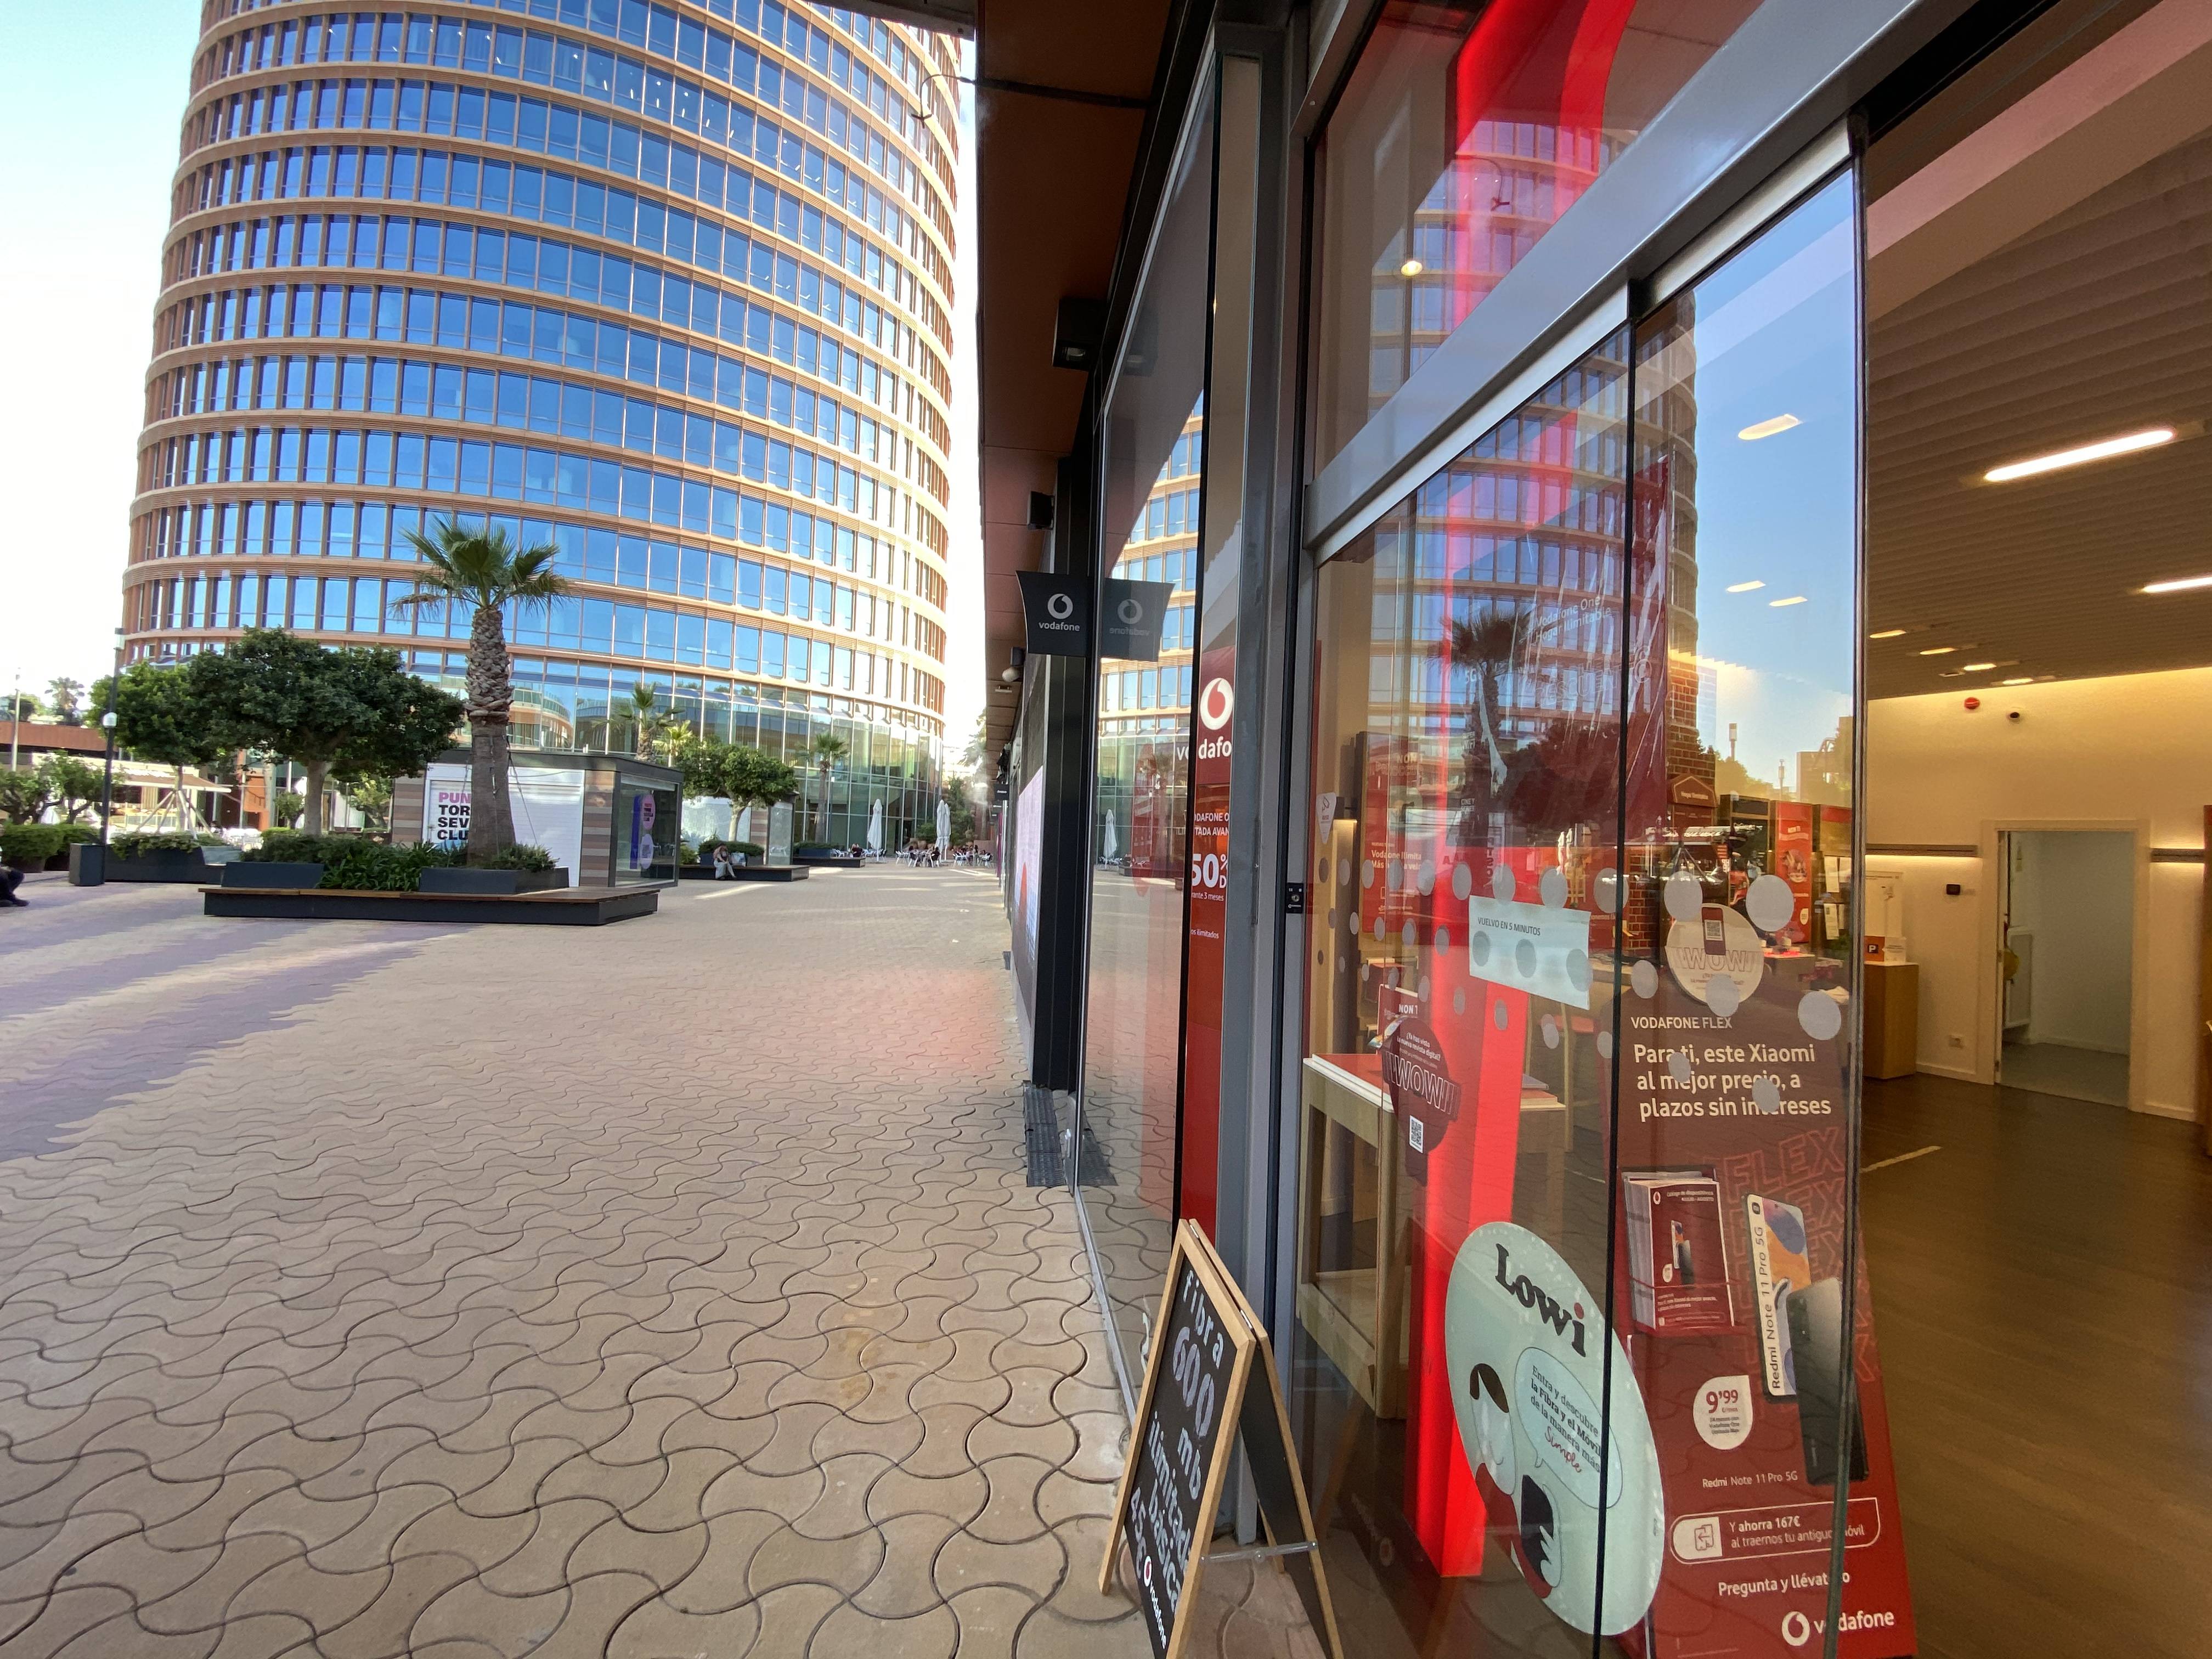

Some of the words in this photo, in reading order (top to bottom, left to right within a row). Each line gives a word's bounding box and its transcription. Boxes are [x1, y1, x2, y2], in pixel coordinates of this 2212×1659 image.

[1039, 622, 1080, 631] vodafone
[1478, 917, 1500, 928] VUELVO
[1500, 921, 1508, 929] EN
[1509, 922, 1513, 930] 5
[1514, 923, 1541, 936] MINUTOS
[1630, 1017, 1700, 1029] VODAFONE
[1702, 1017, 1733, 1029] FLEX
[1704, 1046, 1745, 1063] este
[1748, 1043, 1815, 1063] Xiaomi
[1637, 1070, 1656, 1090] al
[1790, 1074, 1801, 1088] a
[1639, 1098, 1704, 1123] plazos
[1708, 1097, 1737, 1116] sin
[1741, 1096, 1832, 1116] inreses
[1755, 1226, 1764, 1246] 5G
[1759, 1251, 1768, 1277] Pro
[1496, 1243, 1586, 1357] Lowi
[1183, 1269, 1224, 1370] fibra
[1767, 1303, 1775, 1340] Note
[1770, 1347, 1781, 1389] Redmi
[1173, 1327, 1215, 1440] 600
[1533, 1365, 1553, 1391] Entra
[1555, 1388, 1560, 1400] y
[1561, 1395, 1599, 1437] descubre
[1706, 1390, 1738, 1414] 9'99
[1531, 1378, 1538, 1393] la
[1539, 1387, 1559, 1414] Fibra
[1561, 1411, 1566, 1422] y
[1568, 1418, 1575, 1430] el
[1577, 1424, 1601, 1457] Móvil
[1531, 1396, 1540, 1409] de
[1542, 1403, 1548, 1419] la
[1550, 1415, 1580, 1452] manera
[1582, 1448, 1600, 1473] más
[1178, 1427, 1201, 1500] mb
[1545, 1426, 1582, 1474] Simple
[1702, 1477, 1728, 1488] Redmi
[1730, 1476, 1752, 1486] Note
[1767, 1472, 1783, 1482] Pro
[1785, 1471, 1798, 1481] 5G
[1730, 1521, 1735, 1532] Y
[1738, 1520, 1773, 1532] ahorra
[1775, 1515, 1801, 1528] 167€
[1731, 1538, 1740, 1549] al
[1742, 1533, 1783, 1547] traernos
[1785, 1532, 1795, 1543] tu
[1718, 1578, 1778, 1598] Pregunta
[1780, 1578, 1788, 1593] y
[1791, 1571, 1850, 1589] llévato
[1150, 1581, 1167, 1649] vodafone
[1813, 1610, 1895, 1634] vdafone
